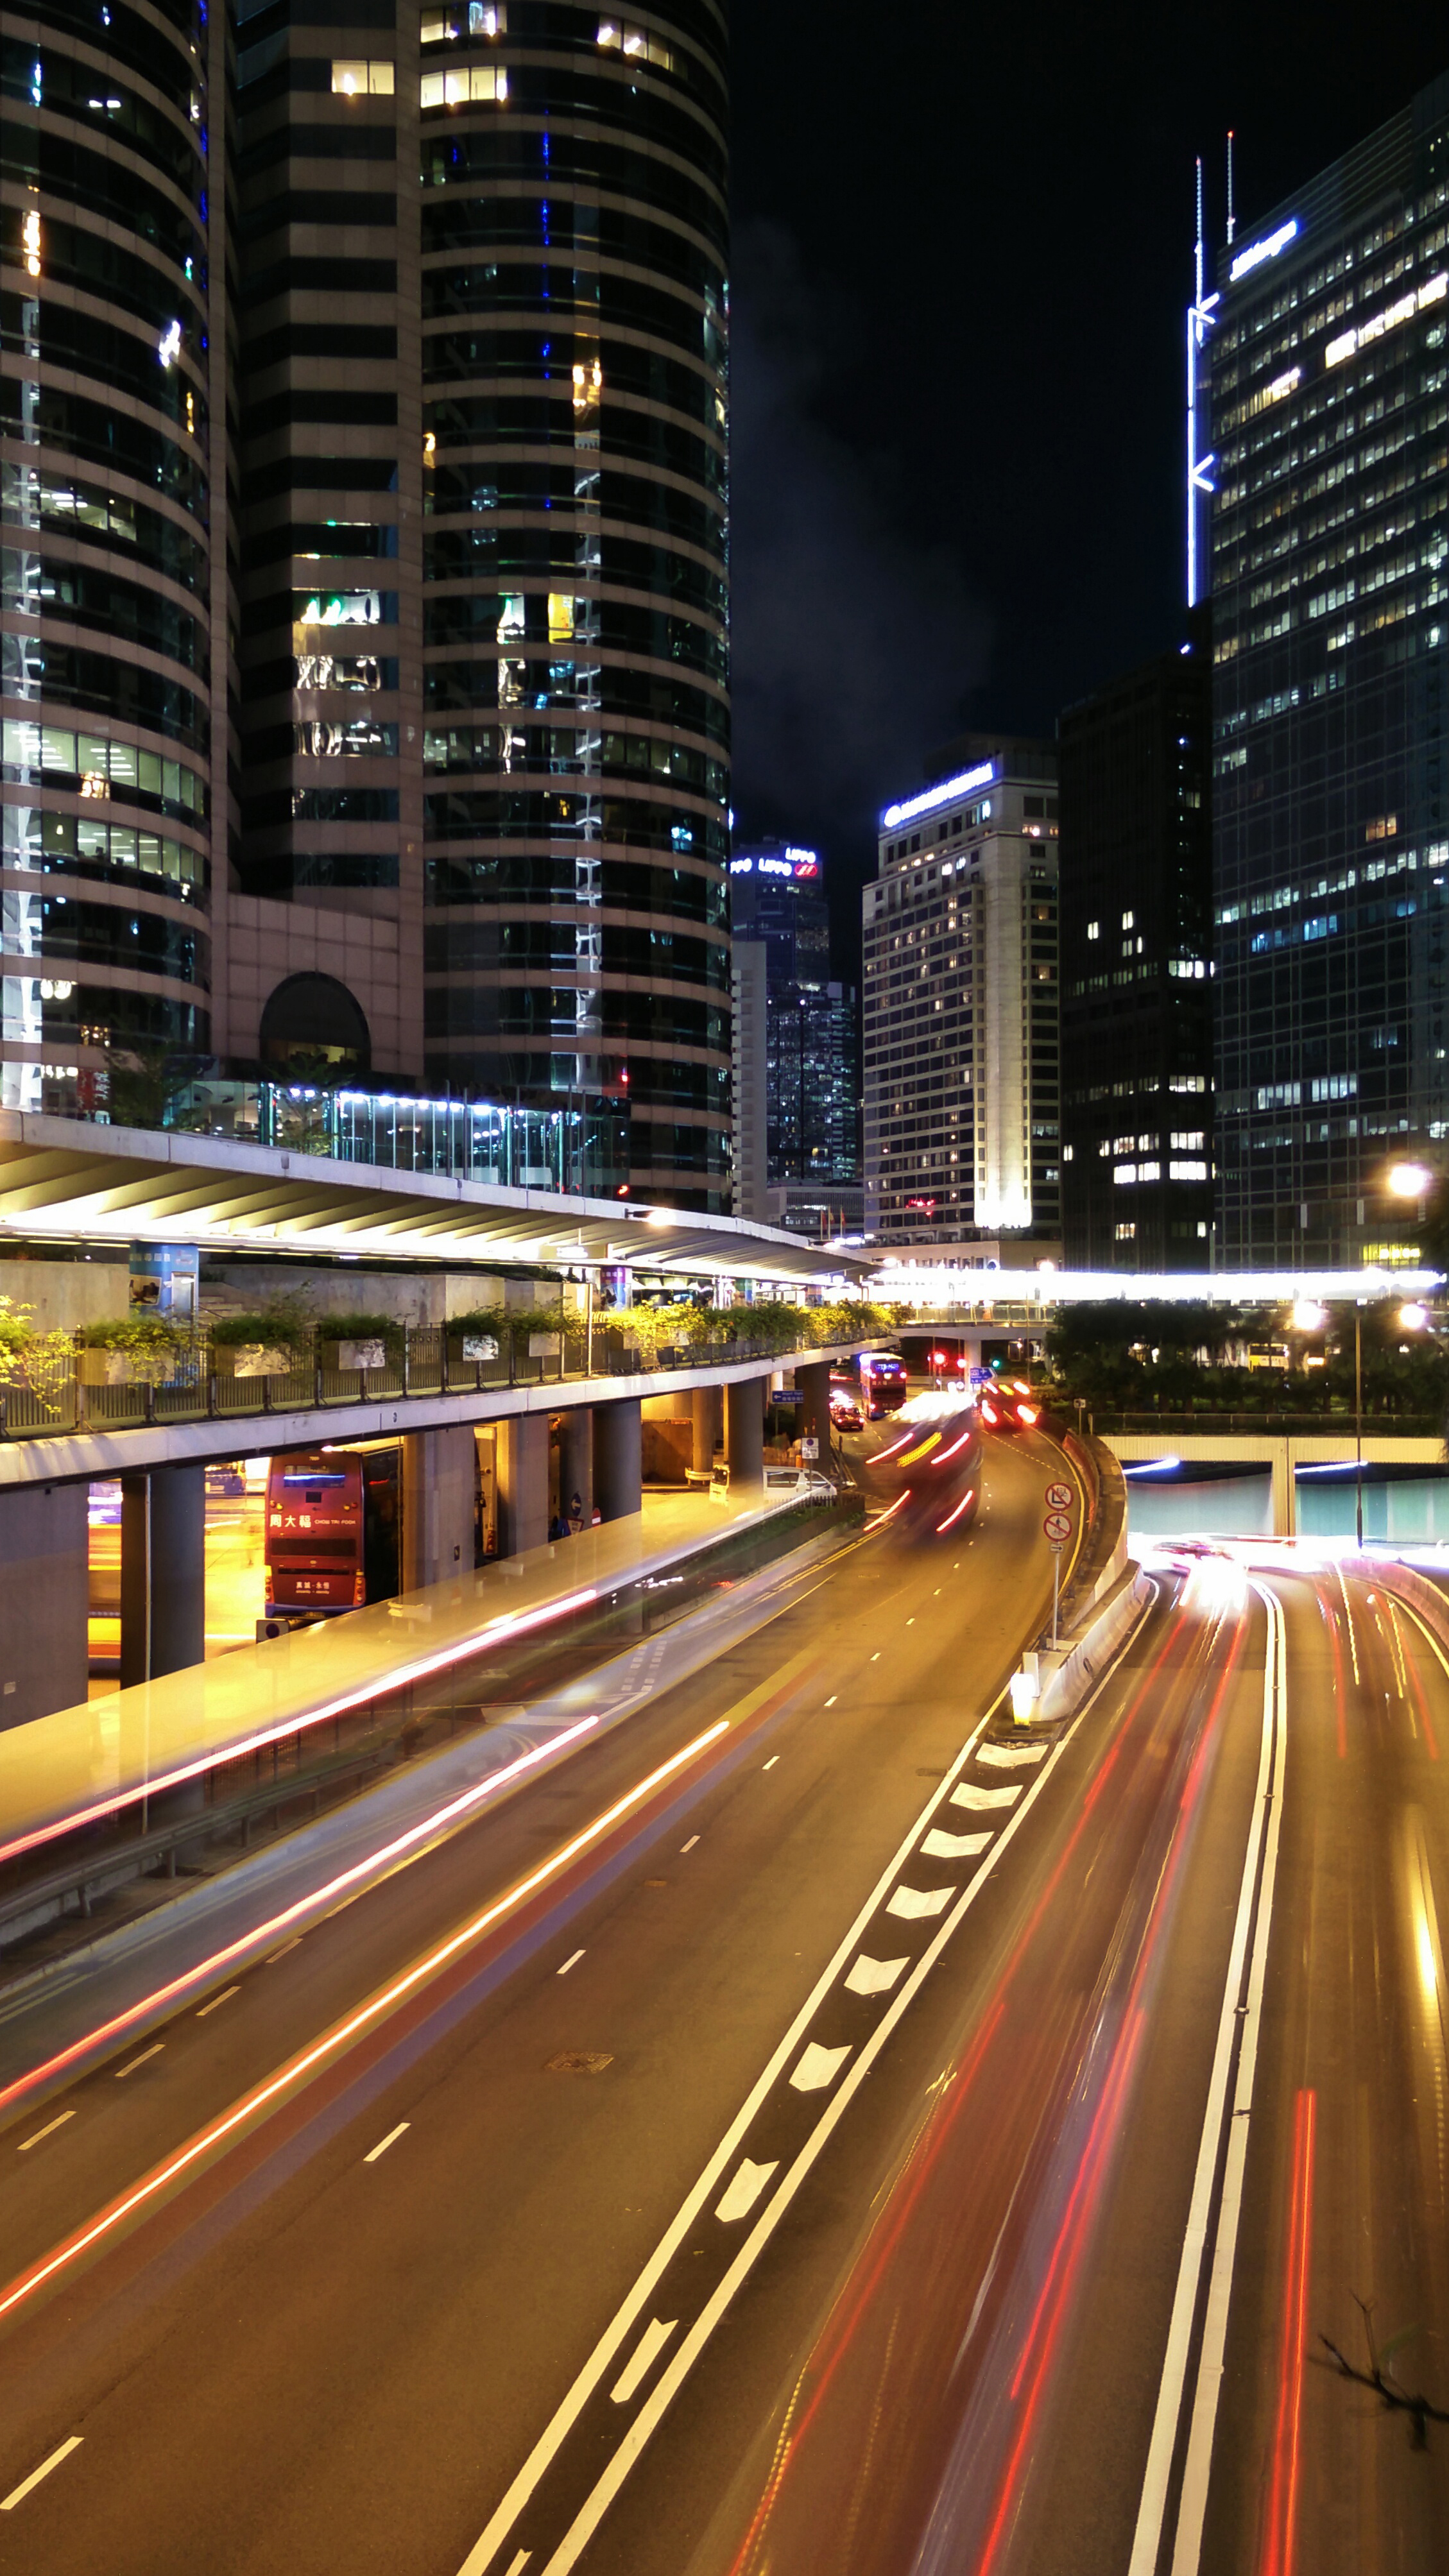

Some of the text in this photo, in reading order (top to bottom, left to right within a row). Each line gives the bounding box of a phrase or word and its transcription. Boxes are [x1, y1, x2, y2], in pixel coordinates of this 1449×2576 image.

[785, 847, 816, 864] LIPPO
[759, 858, 792, 876] LIPPO
[270, 1514, 311, 1528] 周大福
